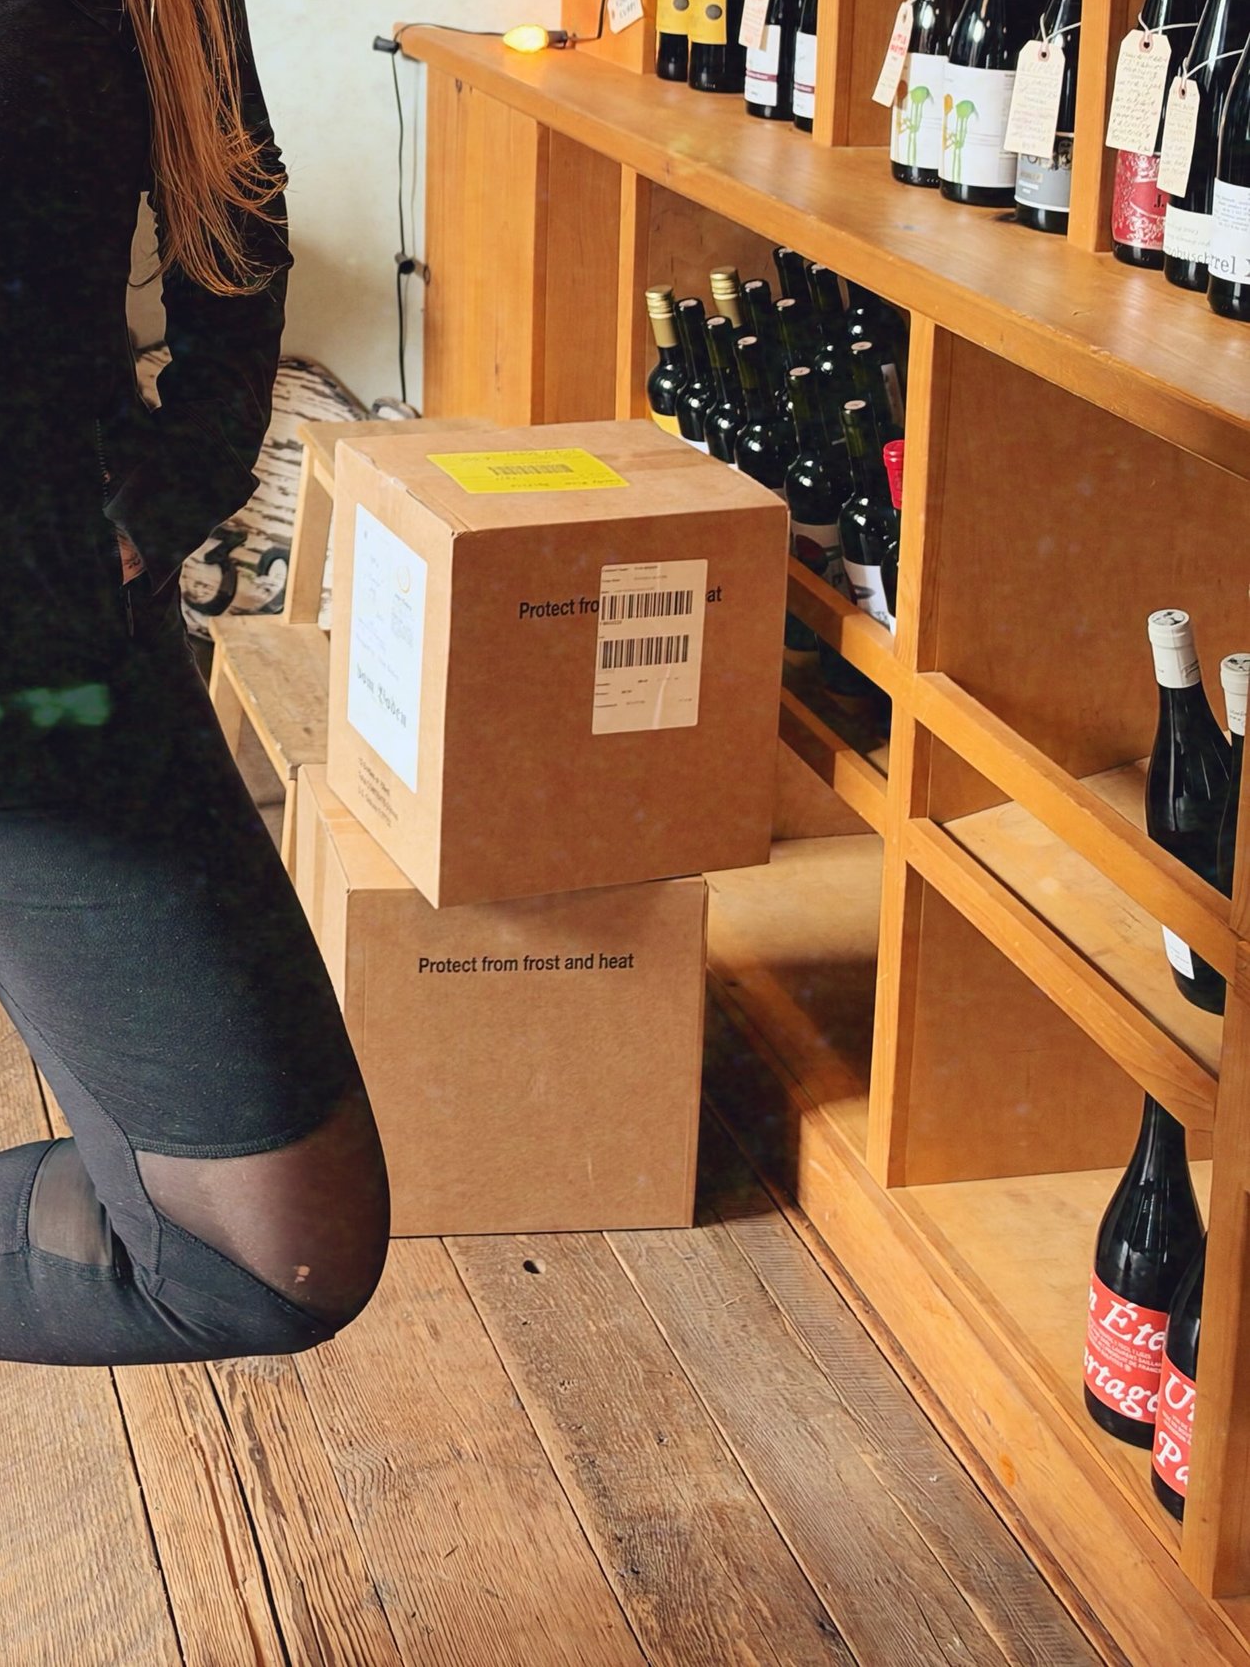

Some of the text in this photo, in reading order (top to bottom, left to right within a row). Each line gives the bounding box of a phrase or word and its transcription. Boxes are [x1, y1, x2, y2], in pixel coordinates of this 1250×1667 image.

[519, 598, 575, 619] Protect
[418, 952, 634, 974] Protect from frost and heat
